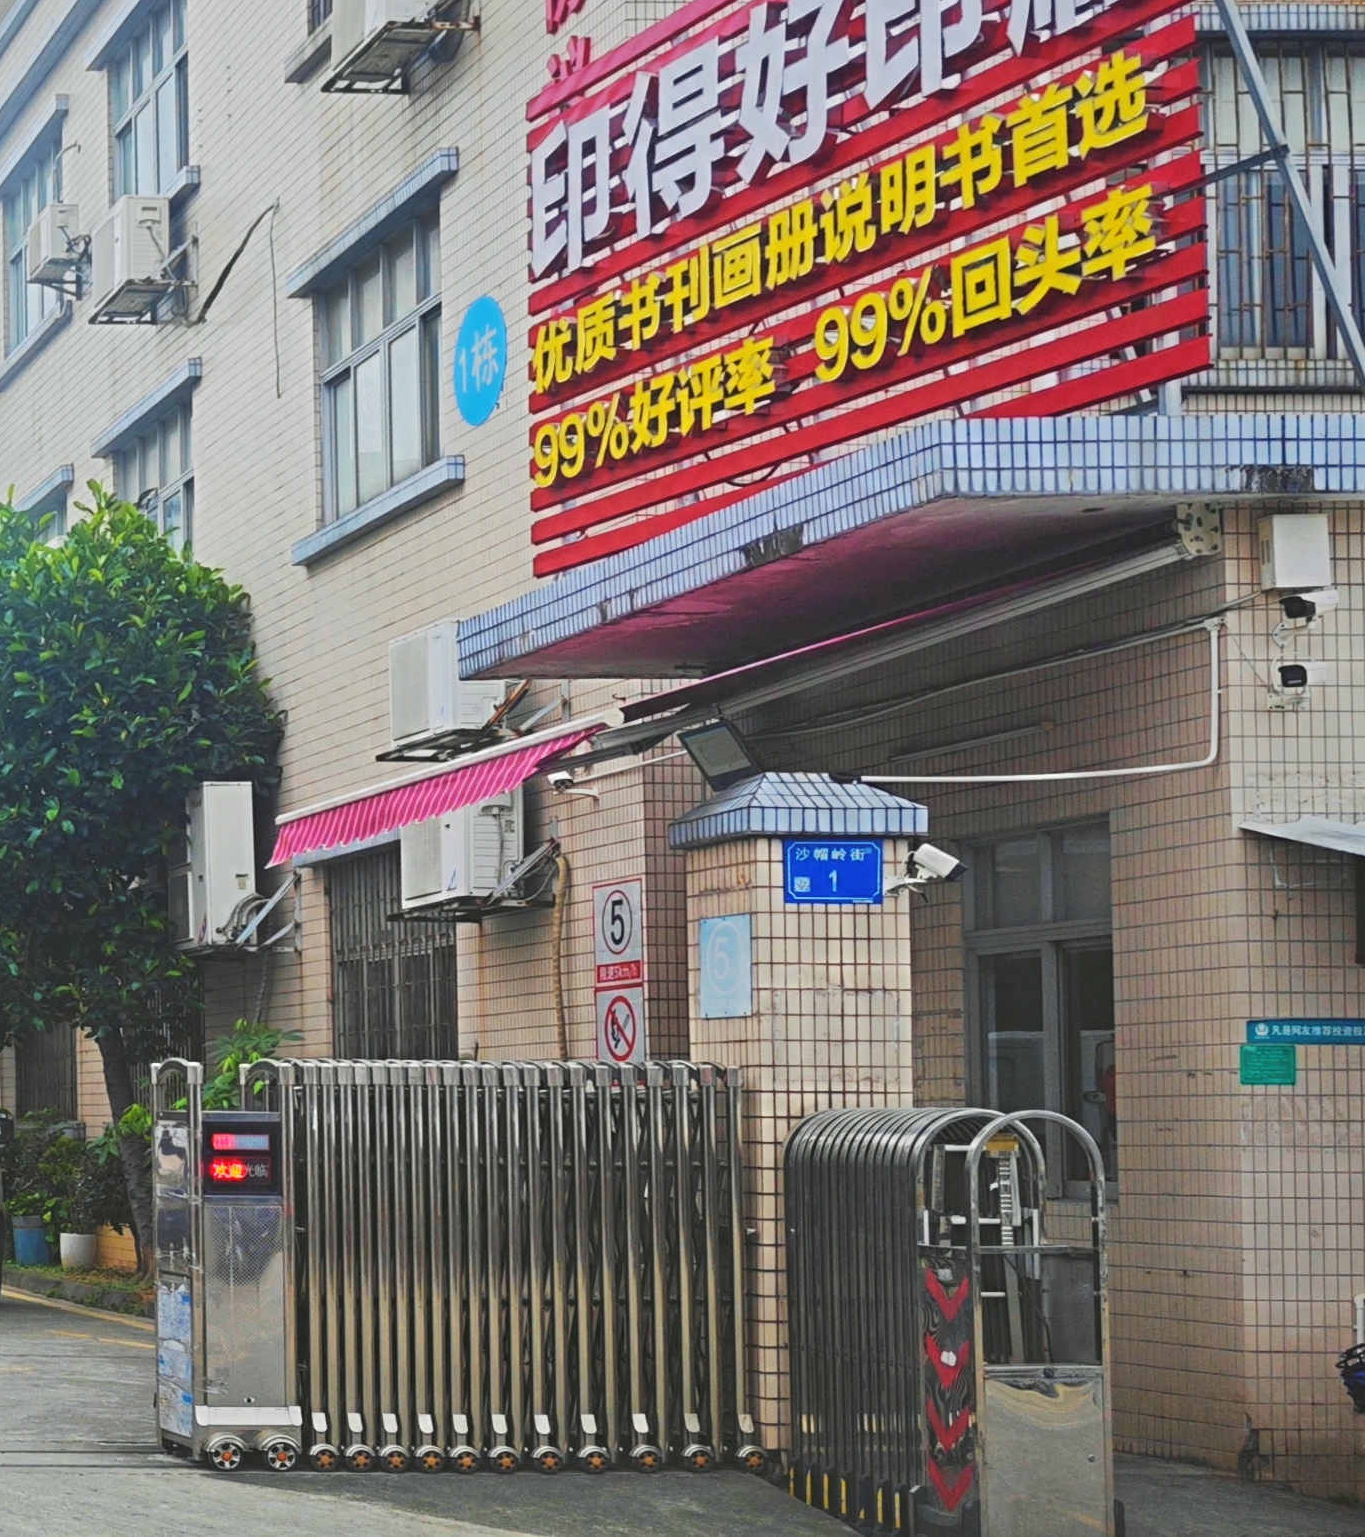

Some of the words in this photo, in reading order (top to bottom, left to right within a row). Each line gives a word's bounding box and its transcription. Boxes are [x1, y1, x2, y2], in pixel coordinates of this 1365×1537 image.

[530, 48, 1151, 395] 优质书刊画册说明书首选
[458, 324, 499, 393] 1栋
[531, 335, 779, 487] 99%好评率
[813, 184, 1158, 383] 99%回头率
[828, 869, 838, 892] 1
[610, 899, 625, 945] 5
[714, 937, 730, 980] 5
